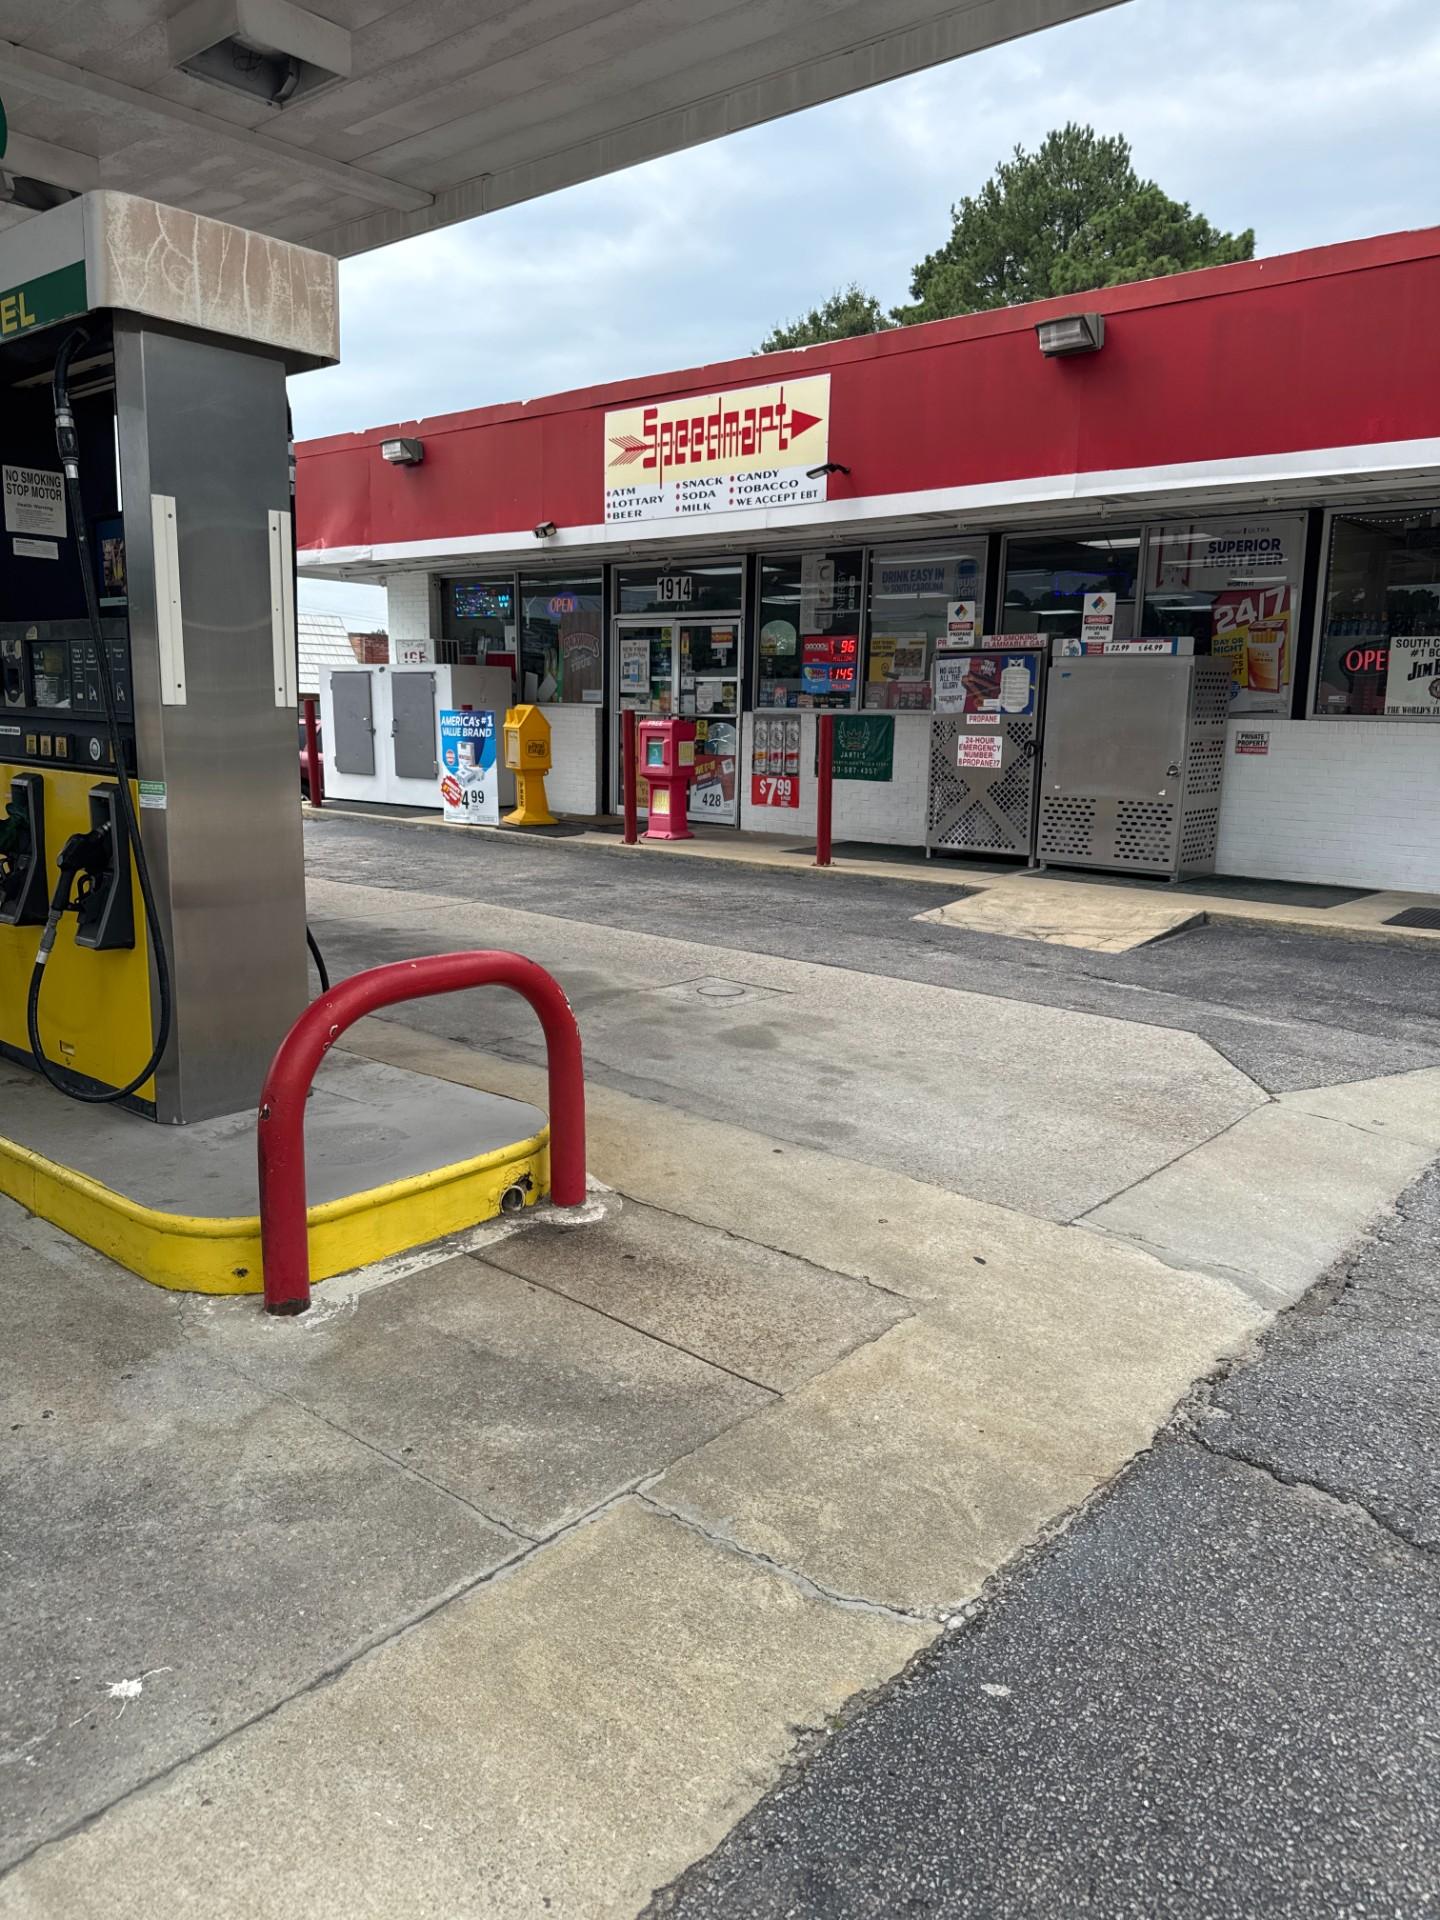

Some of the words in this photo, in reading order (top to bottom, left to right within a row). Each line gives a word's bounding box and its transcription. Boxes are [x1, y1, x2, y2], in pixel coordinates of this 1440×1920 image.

[643, 386, 788, 489] Speedmart
[6, 470, 18, 482] NO
[21, 472, 61, 488] SMOKING
[737, 470, 779, 482] CANDY
[682, 477, 723, 489] SNACK
[737, 480, 799, 494] TOBACCO
[6, 483, 29, 496] STOP
[31, 486, 62, 501] MOTOR
[612, 487, 636, 497] ATM
[682, 490, 716, 501] SODA
[612, 495, 664, 509] LOTTARY
[737, 497, 753, 507] WE
[755, 493, 796, 505] ACCEPT
[800, 490, 817, 499] EBT
[682, 502, 711, 512] MILK
[612, 509, 642, 519] BEER
[1208, 538, 1281, 553] SUPERIOR
[1203, 555, 1243, 568] LIGHT
[1248, 552, 1283, 566] BEER
[882, 571, 909, 583] DRINK
[911, 568, 934, 582] EASY
[935, 568, 944, 580] IN
[658, 578, 690, 600] 1914
[912, 582, 944, 592] CAROLINA
[550, 598, 573, 612] OPEN
[1004, 633, 1038, 641] SMOKING
[841, 640, 855, 653] 96
[984, 640, 1028, 648] FLAMMABLE
[1214, 645, 1242, 653] NIGHT
[1396, 639, 1430, 648] SOUTH
[1411, 649, 1424, 657] #1
[835, 668, 853, 680] 145
[481, 715, 493, 727] #1
[443, 728, 461, 737] VALUE
[463, 728, 492, 737] BRAND
[959, 744, 1000, 752] EMERGENCY
[702, 793, 721, 807] 428
